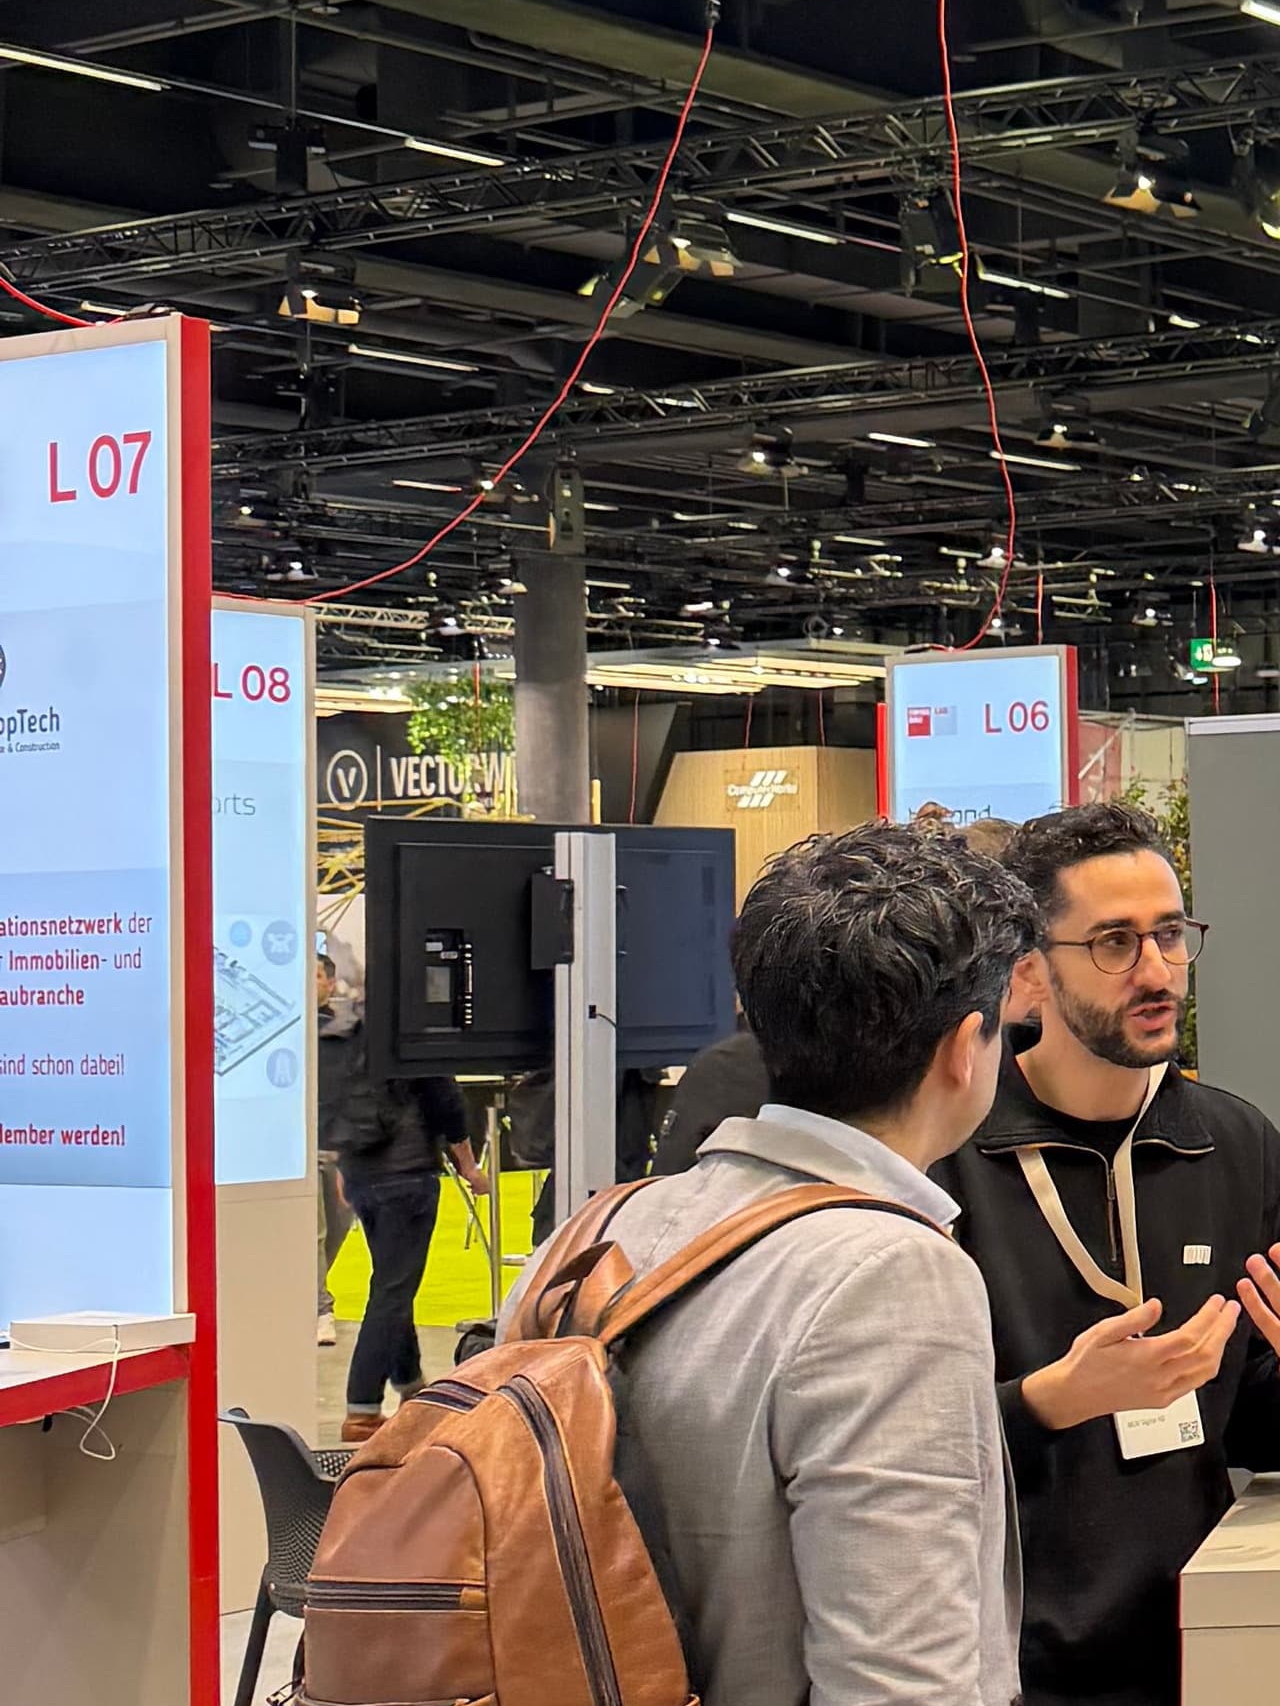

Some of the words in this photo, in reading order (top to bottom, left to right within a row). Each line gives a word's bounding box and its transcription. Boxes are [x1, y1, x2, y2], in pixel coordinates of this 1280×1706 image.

[49, 442, 77, 503] L
[88, 430, 152, 499] 07
[241, 665, 291, 703] 08
[985, 703, 1002, 733] L
[1009, 701, 1050, 733] 06
[0, 912, 122, 936] ationsnetzwerk
[128, 912, 153, 934] der
[9, 949, 107, 971] Immobilien-
[114, 946, 142, 970] und
[0, 983, 85, 1006] aubranche
[32, 1054, 74, 1075] schon
[80, 1054, 125, 1075] dabei!
[60, 1125, 126, 1147] werden!
